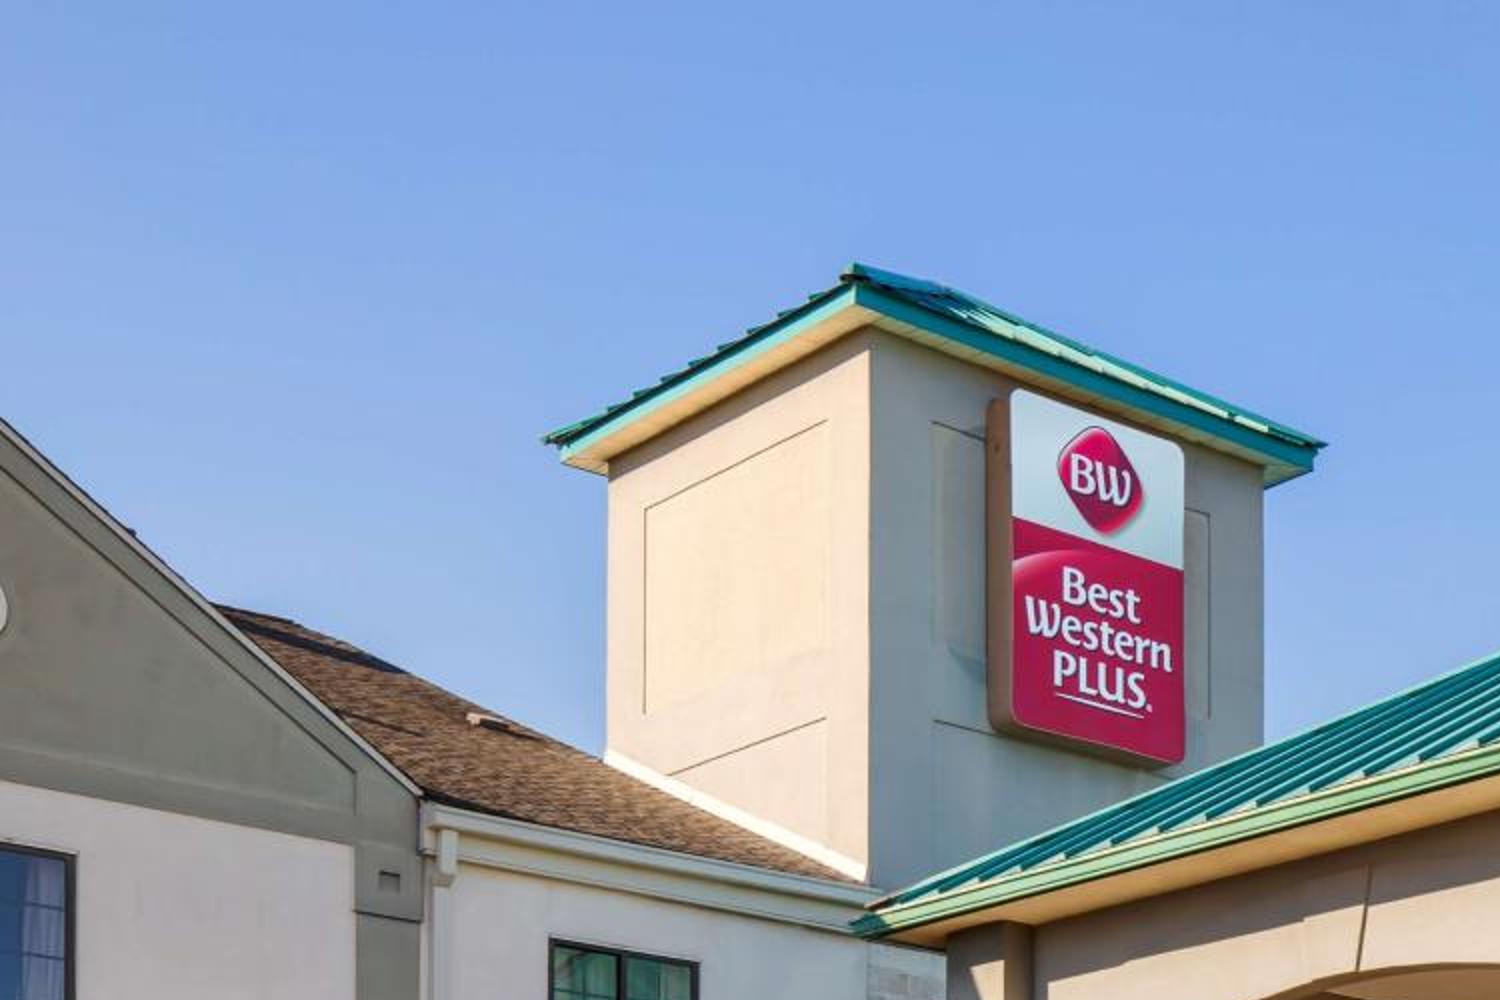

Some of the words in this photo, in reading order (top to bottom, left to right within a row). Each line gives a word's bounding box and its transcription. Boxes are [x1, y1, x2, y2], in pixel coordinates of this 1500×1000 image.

[1070, 453, 1131, 507] BW
[1062, 566, 1141, 624] Best
[1025, 596, 1173, 672] Western
[1053, 649, 1147, 709] PLUS
